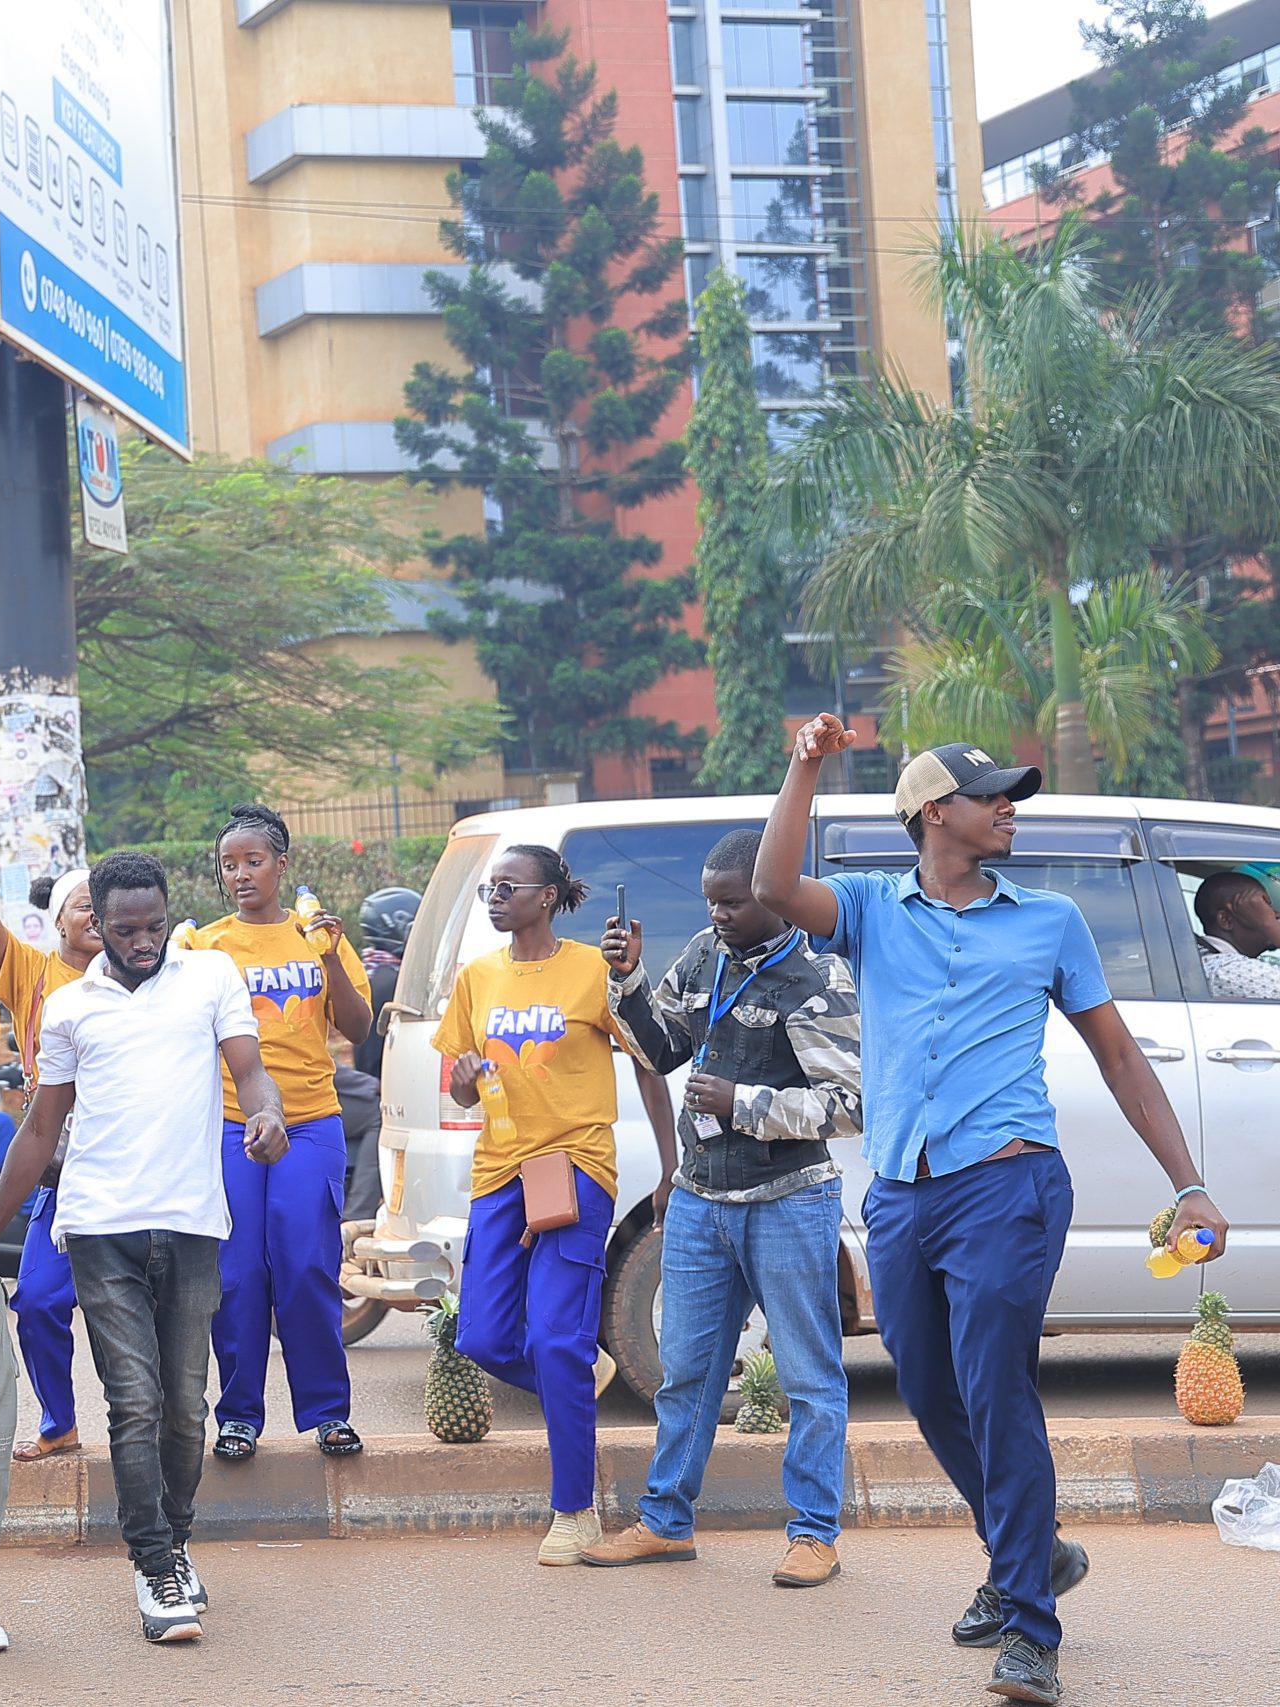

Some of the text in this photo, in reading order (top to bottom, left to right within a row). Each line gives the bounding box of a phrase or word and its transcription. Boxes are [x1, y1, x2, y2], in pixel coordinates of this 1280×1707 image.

[60, 92, 117, 173] KEY FEATURES
[245, 962, 322, 993] FANTA
[486, 1006, 565, 1036] FANTA
